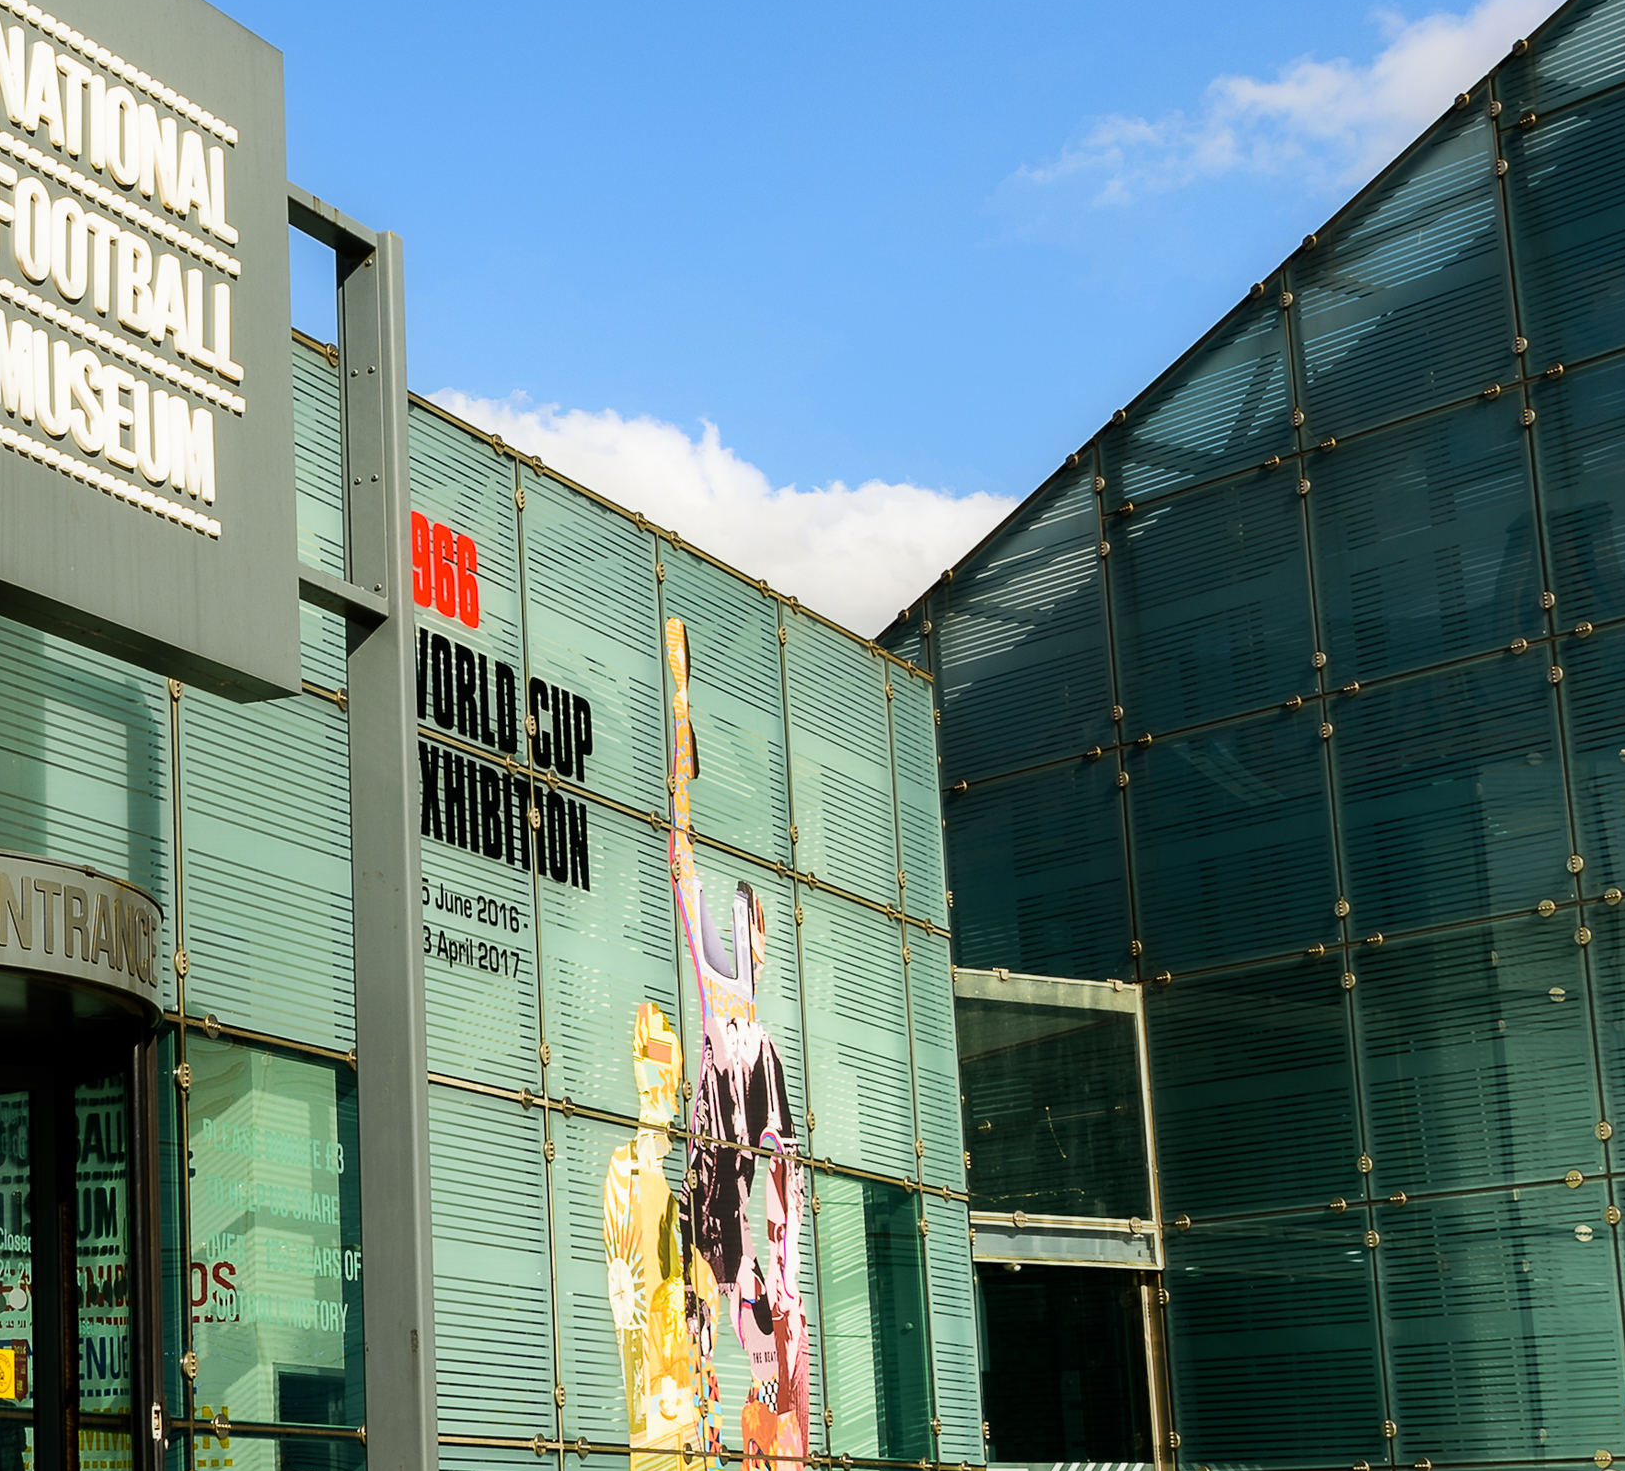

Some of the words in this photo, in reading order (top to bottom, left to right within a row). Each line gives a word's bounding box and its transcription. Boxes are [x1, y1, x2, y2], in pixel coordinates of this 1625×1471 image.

[410, 510, 479, 629] 966
[529, 676, 594, 783] CUP
[418, 739, 591, 892] XHIBITION
[422, 878, 430, 906] 5
[435, 883, 472, 918] June
[477, 895, 520, 933] 2016
[423, 925, 432, 953] 3
[437, 930, 474, 967] April
[478, 941, 520, 978] 2017
[202, 1118, 260, 1159] PLEASE
[293, 1190, 340, 1226] SHARE
[345, 1250, 361, 1281] OF
